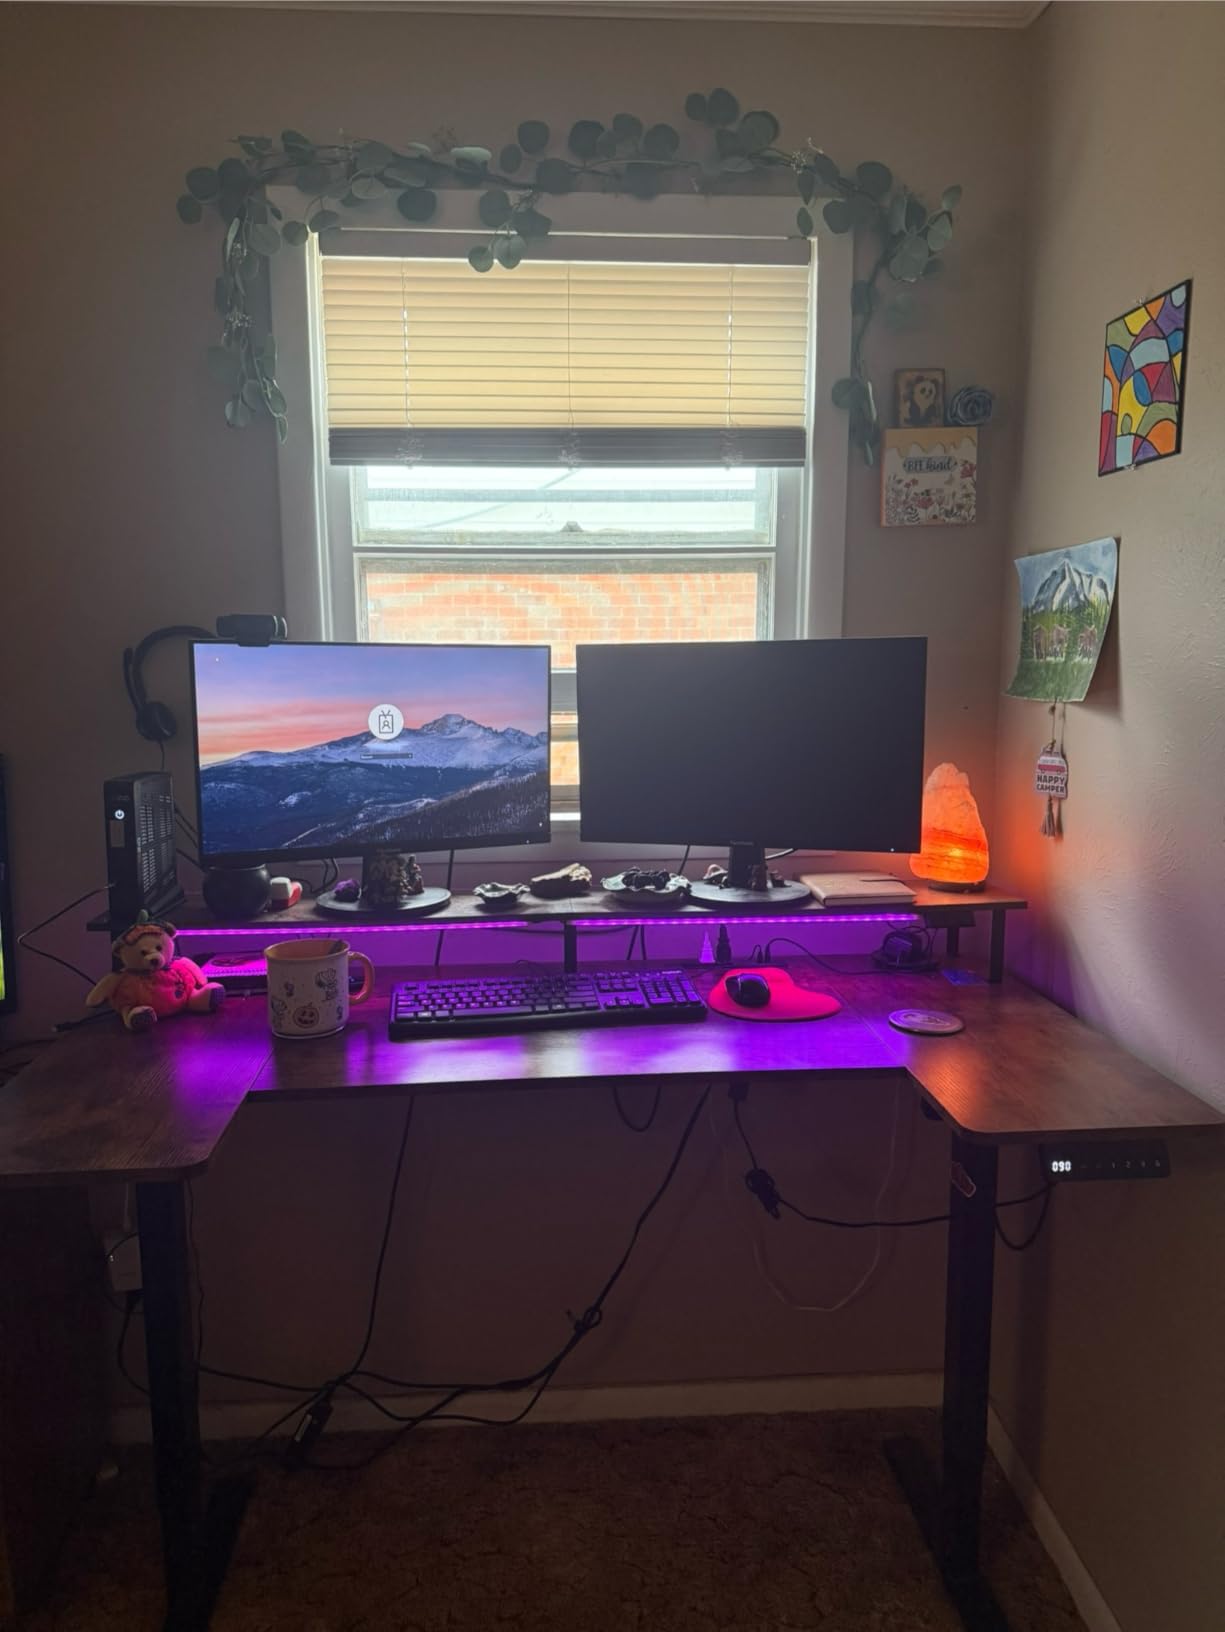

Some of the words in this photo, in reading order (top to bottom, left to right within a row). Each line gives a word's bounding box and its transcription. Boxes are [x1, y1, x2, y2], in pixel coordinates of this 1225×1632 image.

[1037, 775, 1065, 785] HAPPY
[1036, 784, 1065, 793] CAMPER
[1052, 1161, 1071, 1172] 090
